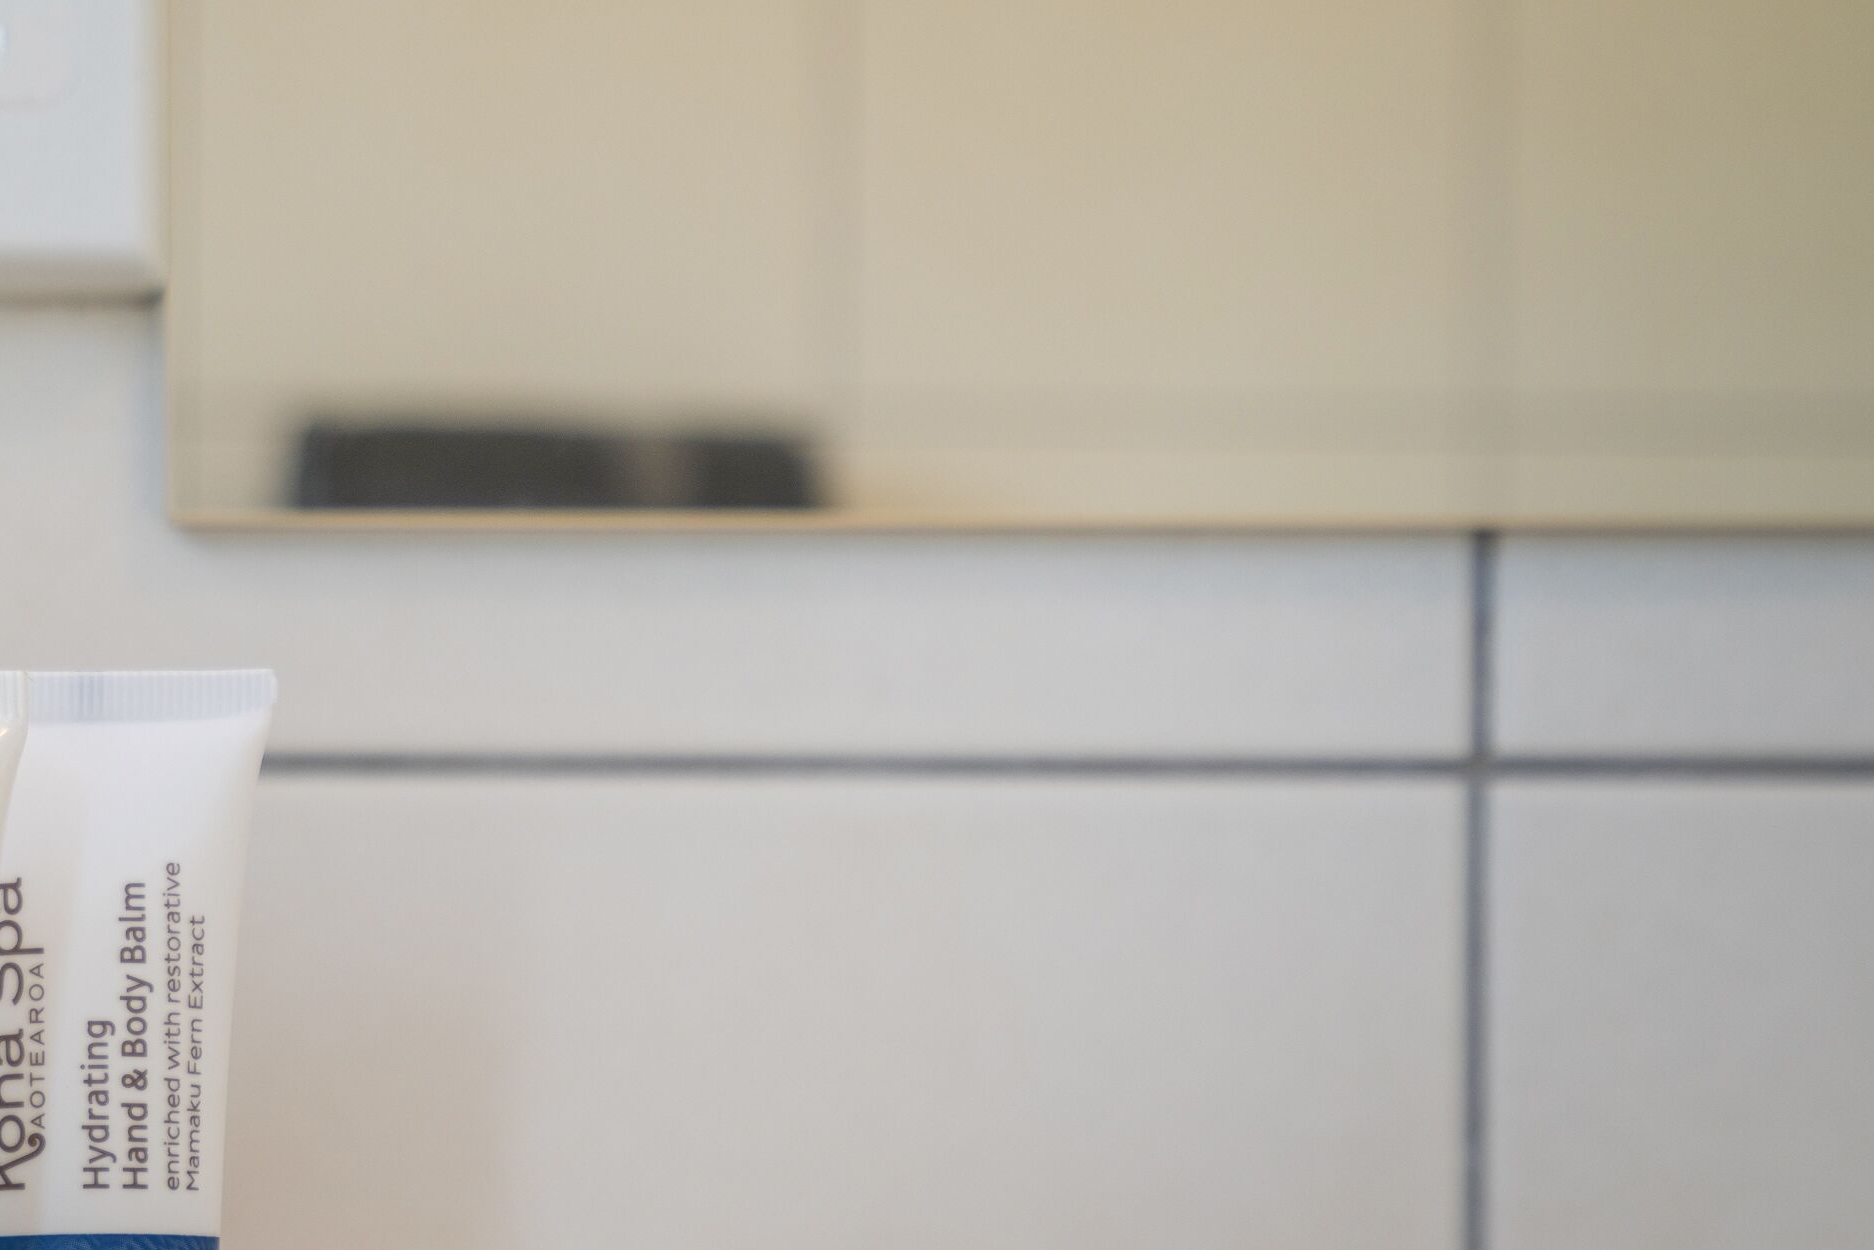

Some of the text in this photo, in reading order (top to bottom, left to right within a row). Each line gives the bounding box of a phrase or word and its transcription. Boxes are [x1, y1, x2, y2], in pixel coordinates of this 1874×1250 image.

[28, 962, 46, 1129] AOTEAROA
[80, 1019, 116, 1189] Hydrating
[118, 881, 154, 1189] Hand & Body Balm
[163, 861, 181, 1191] enriched with restorative
[186, 915, 205, 1191] Mamaku Fern Extract
